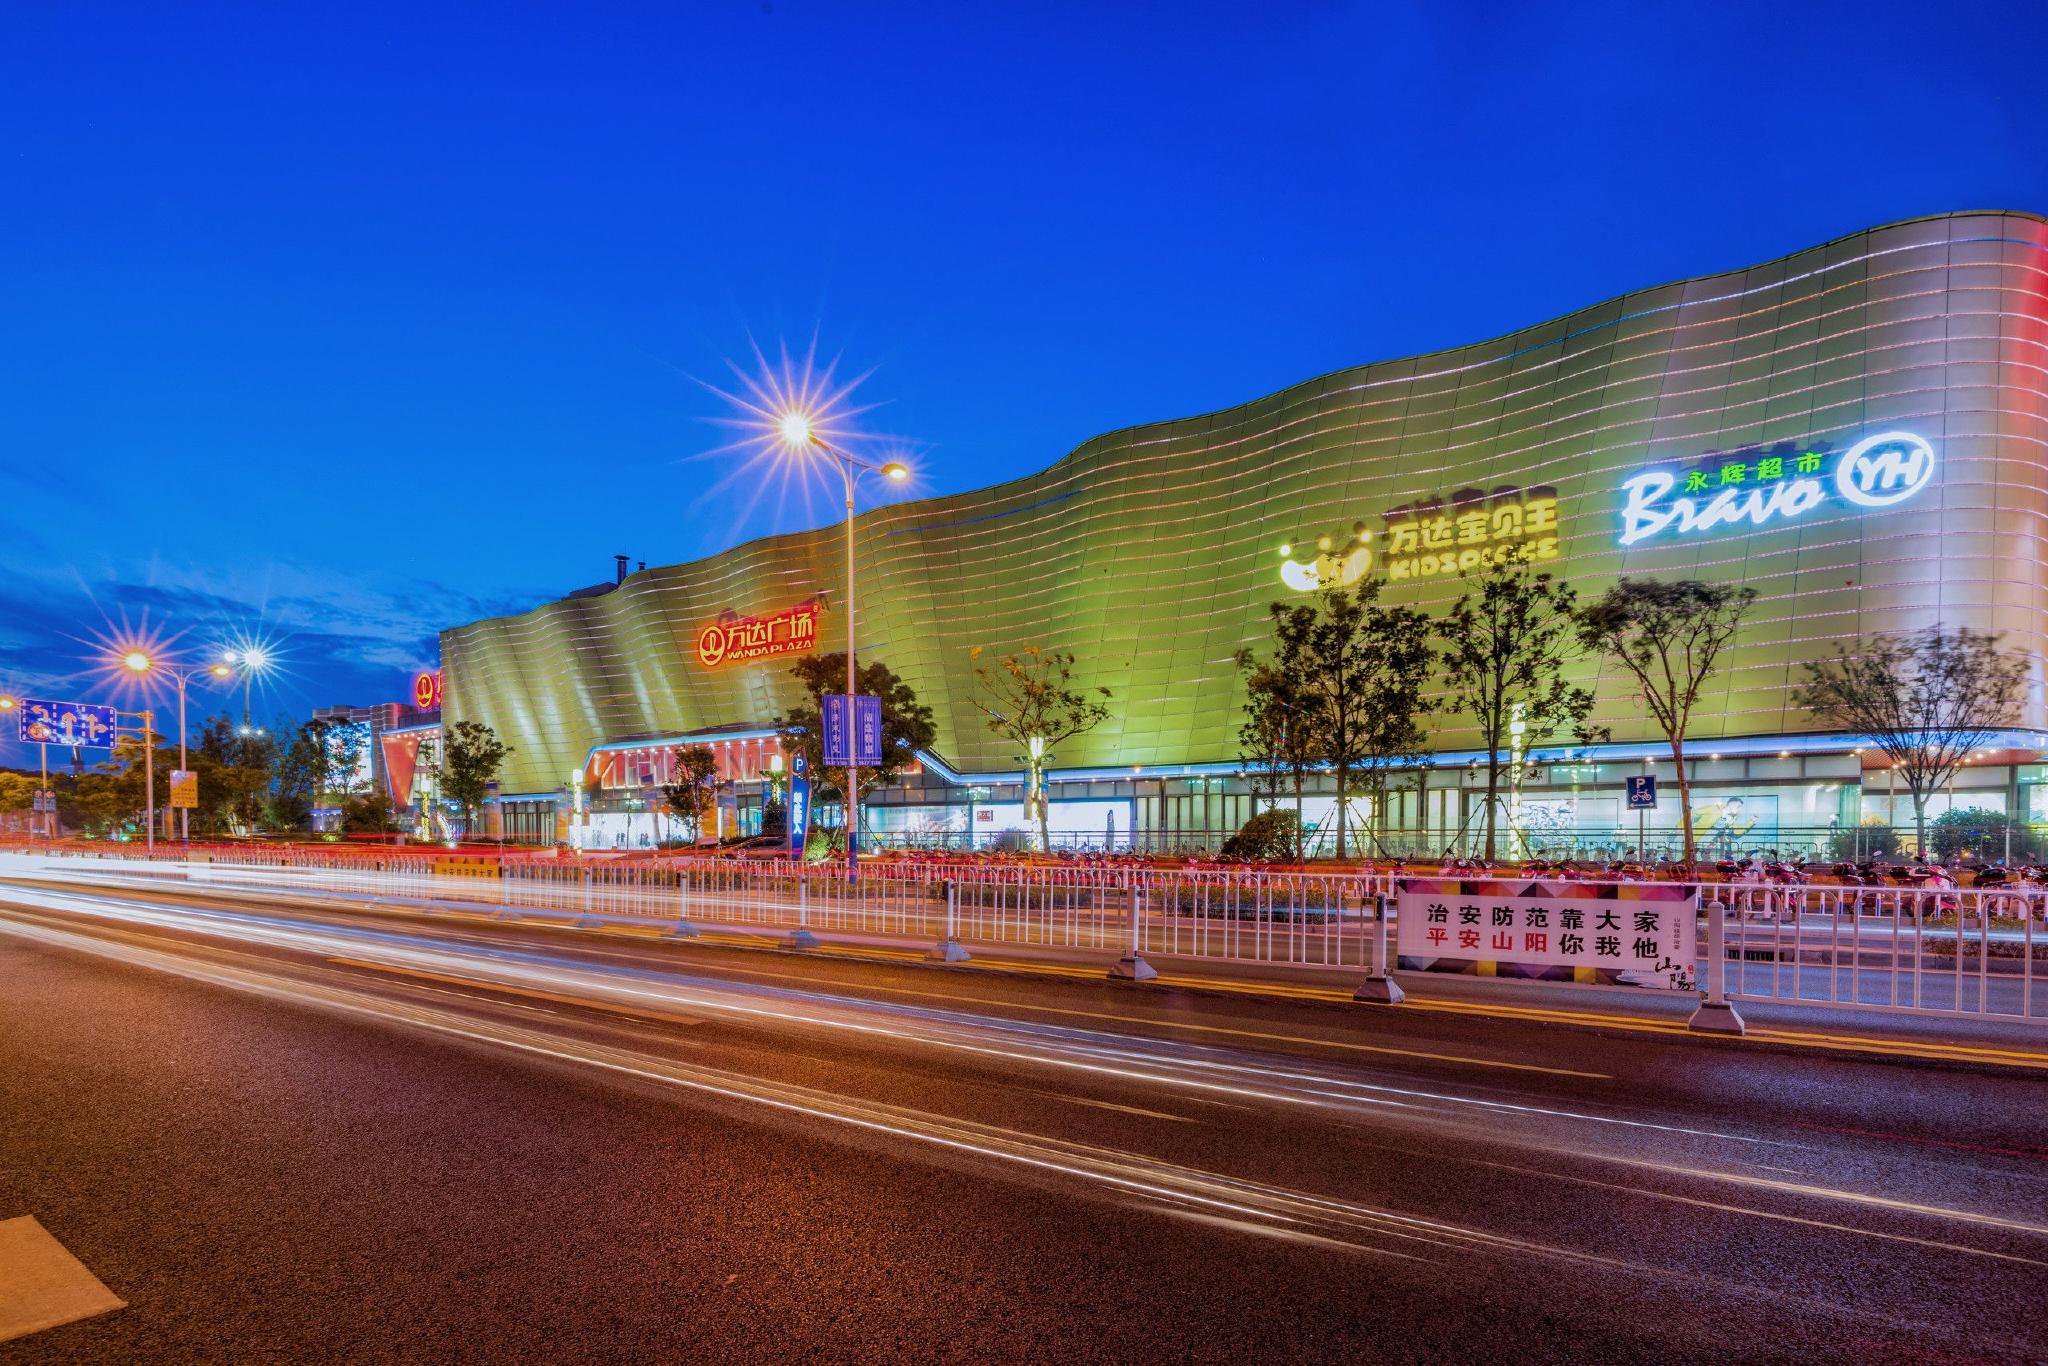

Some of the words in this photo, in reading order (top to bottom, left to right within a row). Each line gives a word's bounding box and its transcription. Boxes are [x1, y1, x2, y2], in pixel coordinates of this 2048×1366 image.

[1685, 452, 1823, 492] 永辉超市
[1619, 472, 1825, 545] Bravo
[1388, 499, 1557, 554] 万达宝贝王
[726, 612, 813, 650] 万达广场
[727, 646, 768, 660] WANDA
[770, 640, 812, 654] PLAZA
[796, 758, 804, 771] P
[1635, 778, 1646, 789] P
[1426, 903, 1660, 933] 治安防范靠大家
